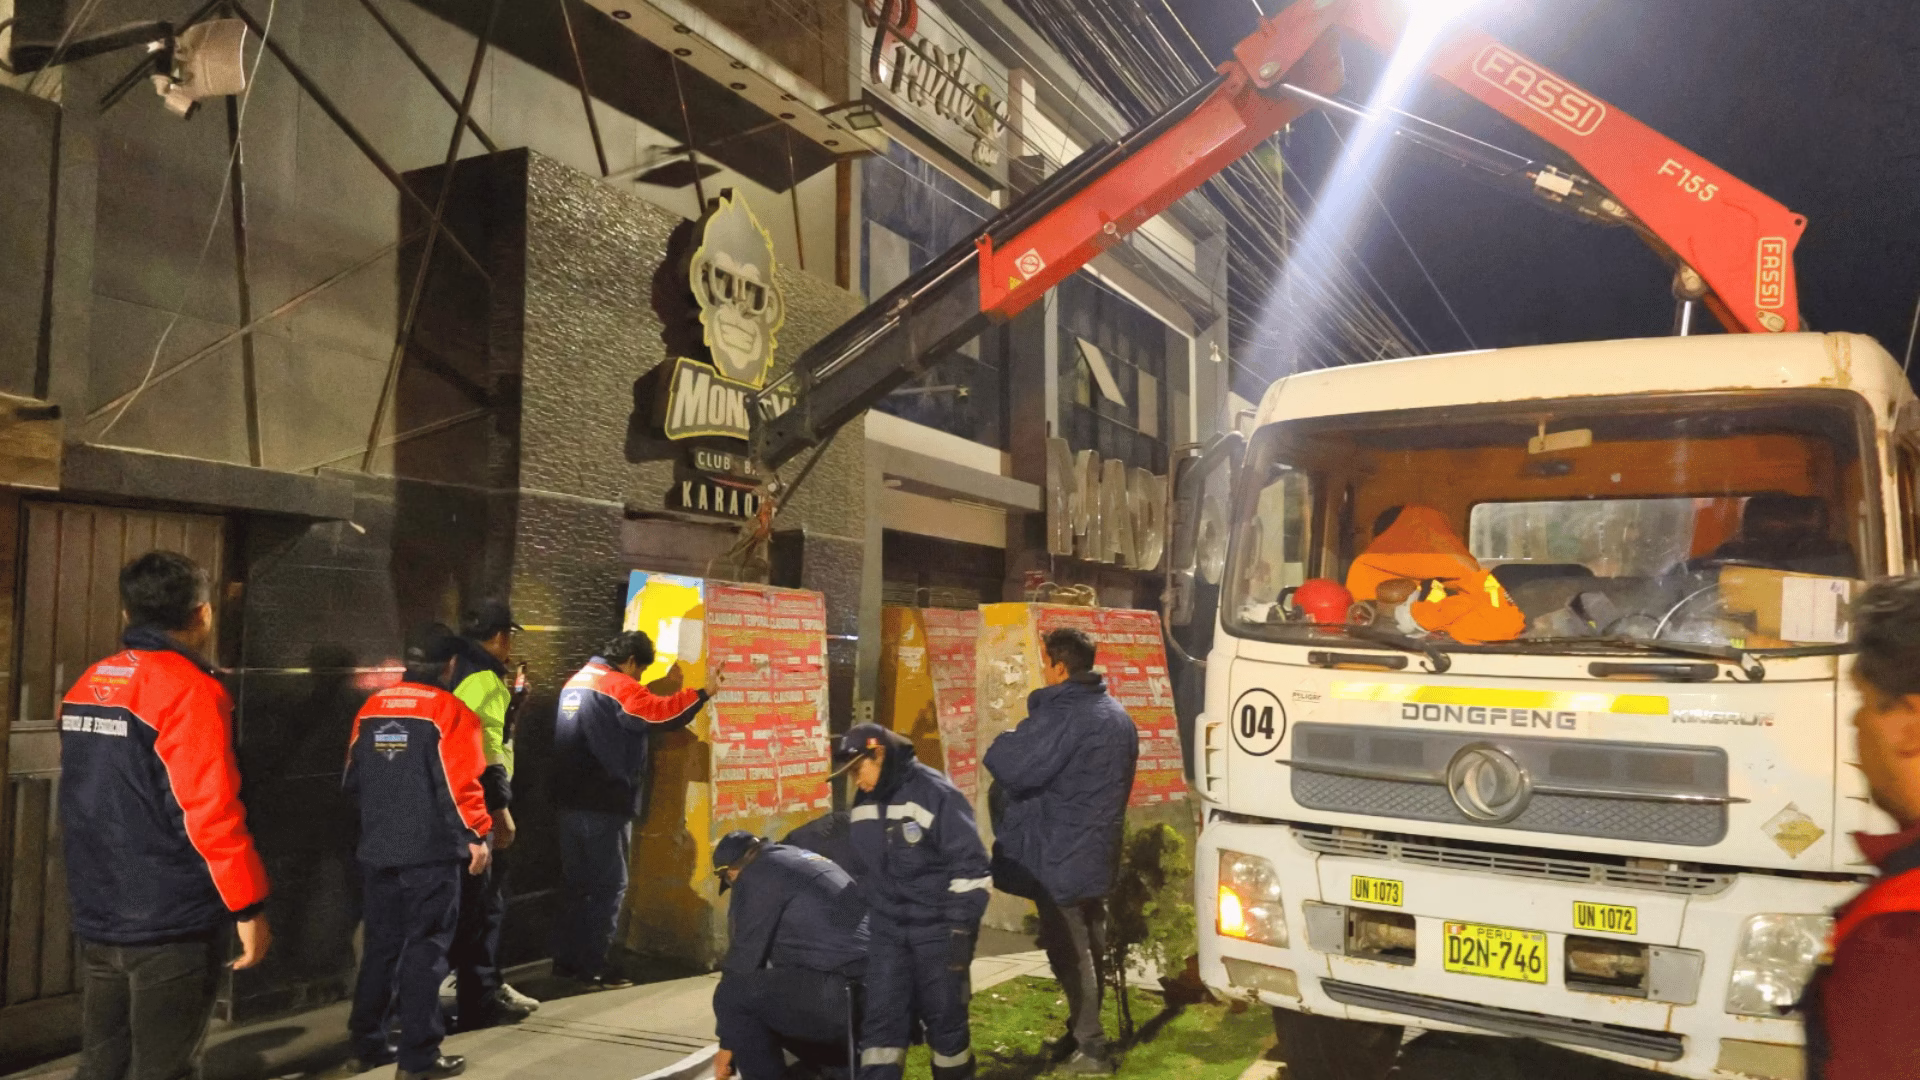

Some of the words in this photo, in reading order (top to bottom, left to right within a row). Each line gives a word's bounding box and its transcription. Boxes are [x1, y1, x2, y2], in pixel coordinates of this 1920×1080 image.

[1483, 51, 1595, 128] FASSI
[1658, 160, 1718, 201] F155
[1762, 243, 1781, 303] FASSI
[698, 452, 731, 470] CLUB
[1241, 705, 1274, 739] 04
[1402, 703, 1576, 729] DONGFENG
[1355, 880, 1369, 898] UN
[1374, 882, 1399, 903] 1073
[1578, 905, 1596, 928] UN
[1601, 909, 1632, 932] 1072
[1477, 929, 1513, 941] PERU
[1449, 936, 1542, 974] D2N-746
